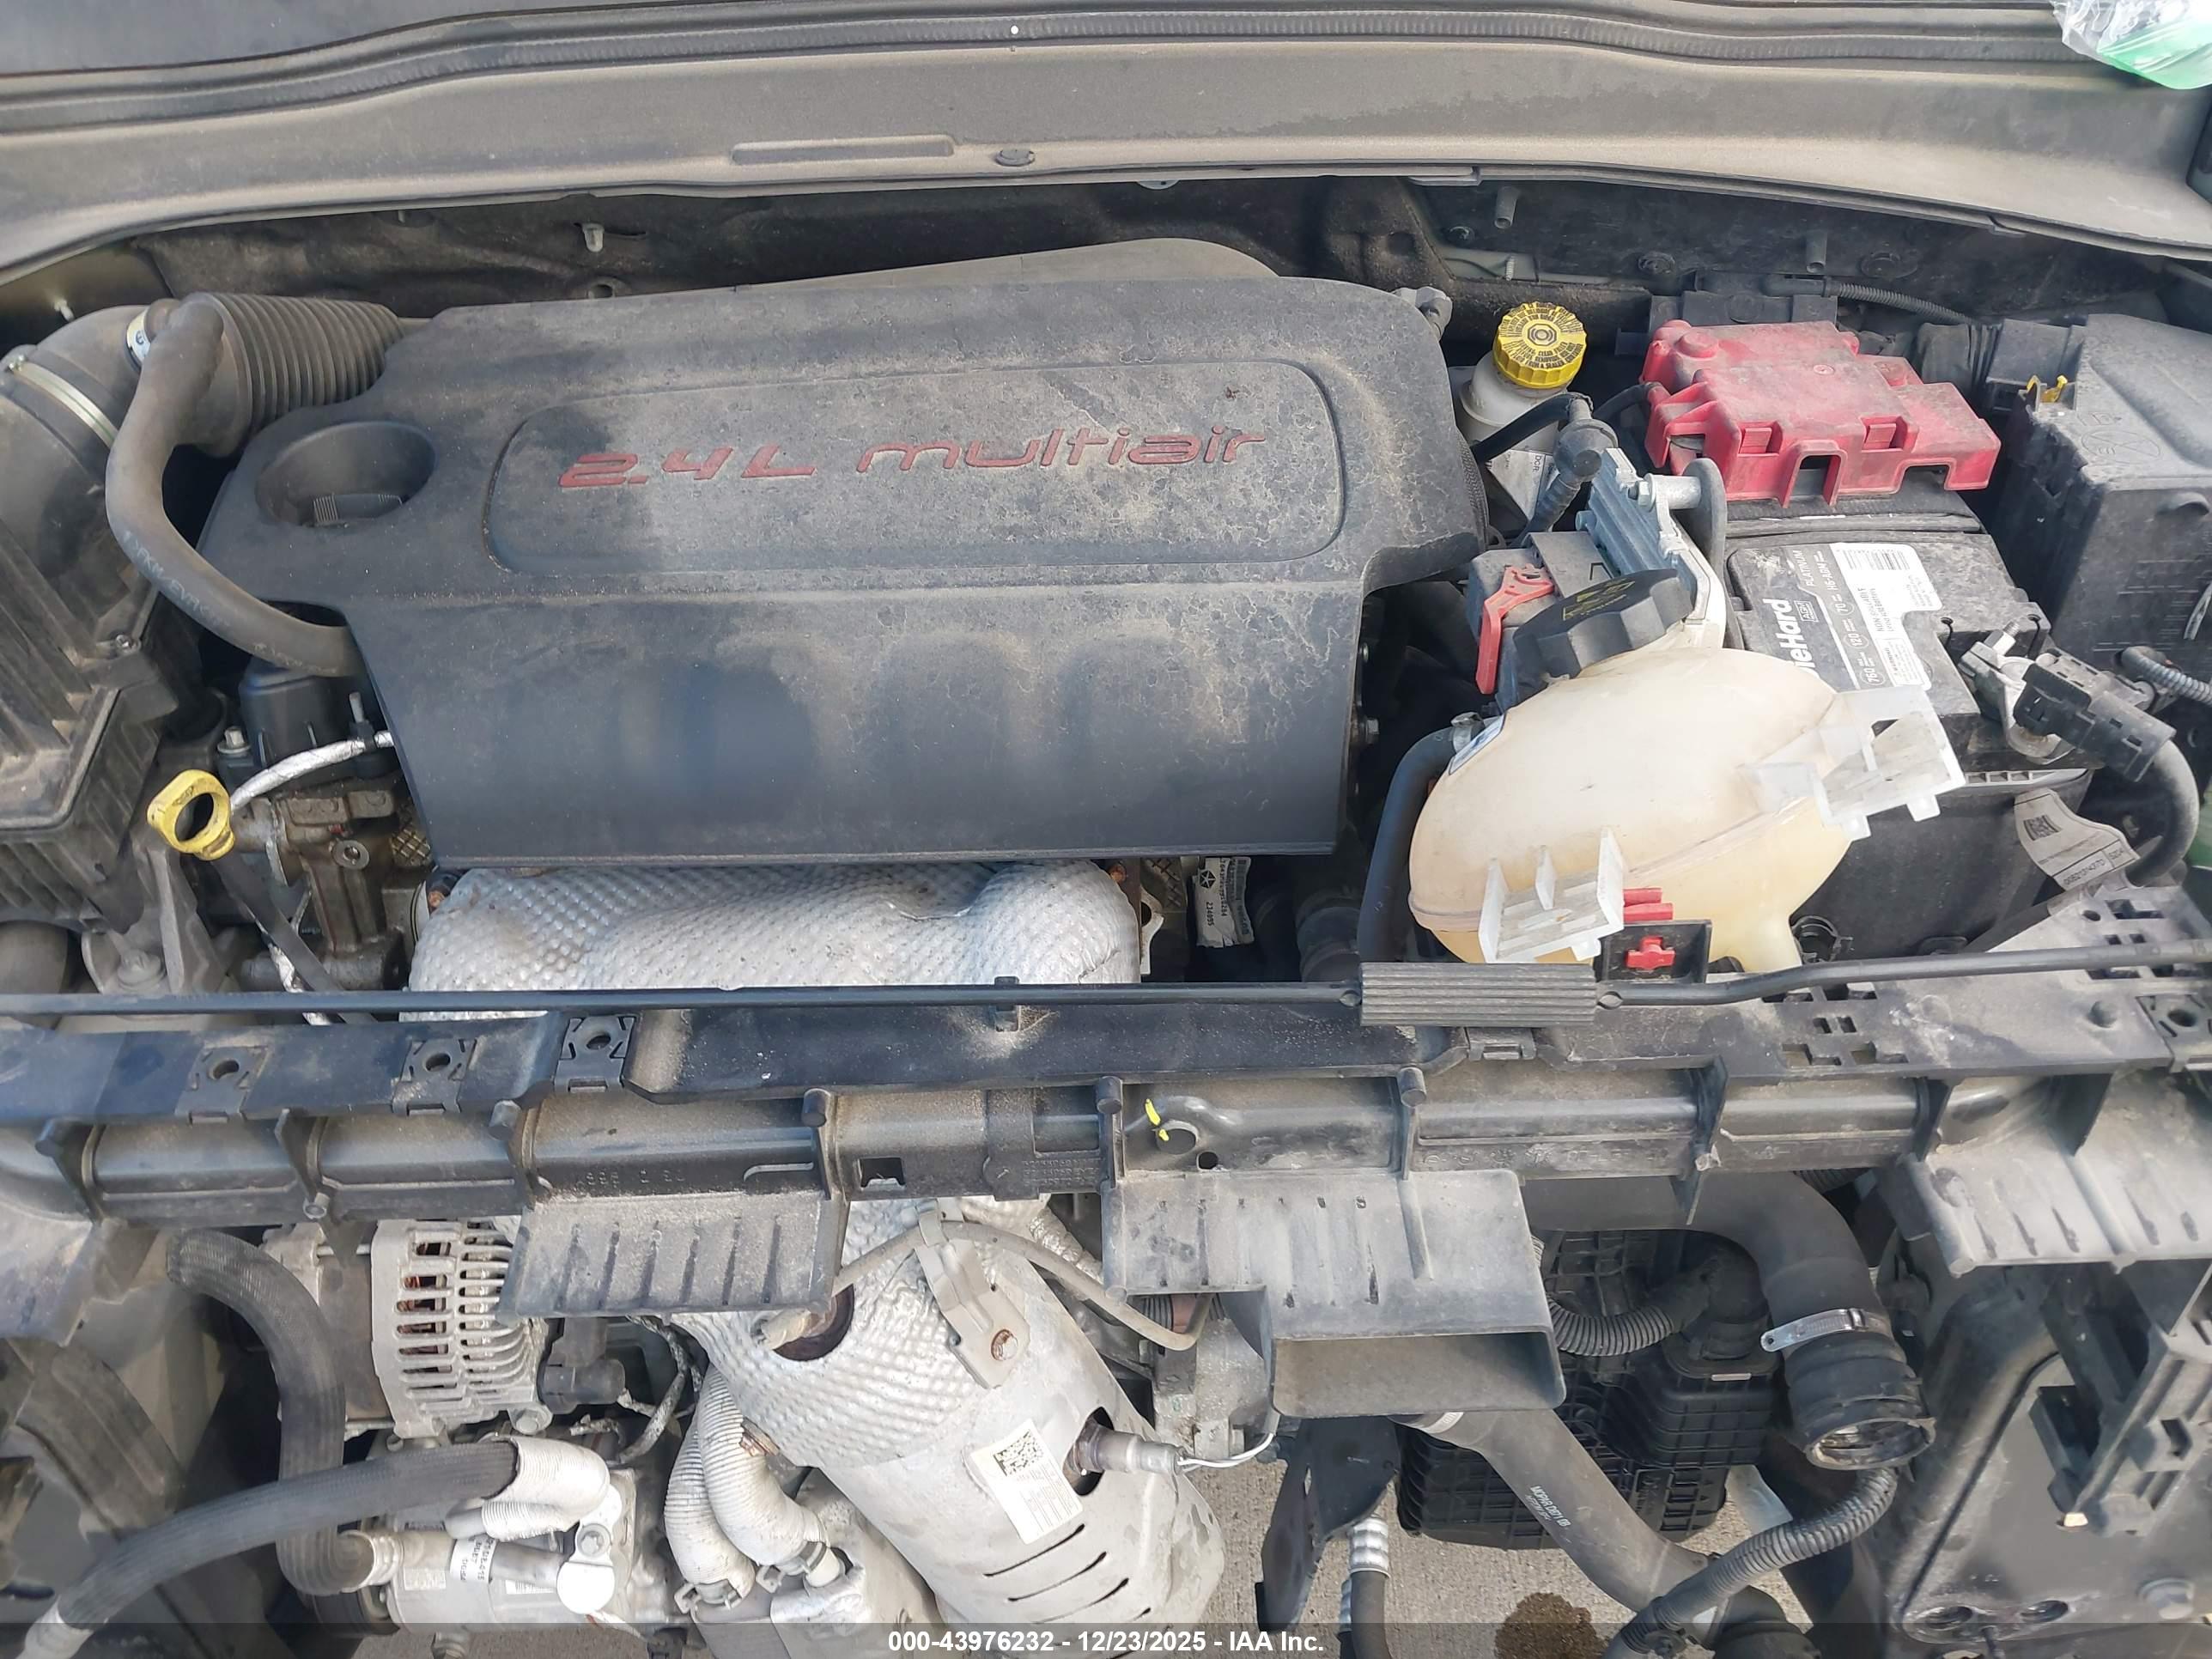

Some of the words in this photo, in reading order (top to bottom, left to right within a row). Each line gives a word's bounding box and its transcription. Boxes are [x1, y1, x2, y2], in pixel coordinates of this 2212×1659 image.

[558, 444, 815, 489] 2.4L
[858, 424, 1267, 473] multiair
[1792, 550, 1814, 586] PLATINUM
[1834, 603, 1848, 613] 70
[1762, 598, 1817, 673] ieHard
[1848, 632, 1862, 646] 120
